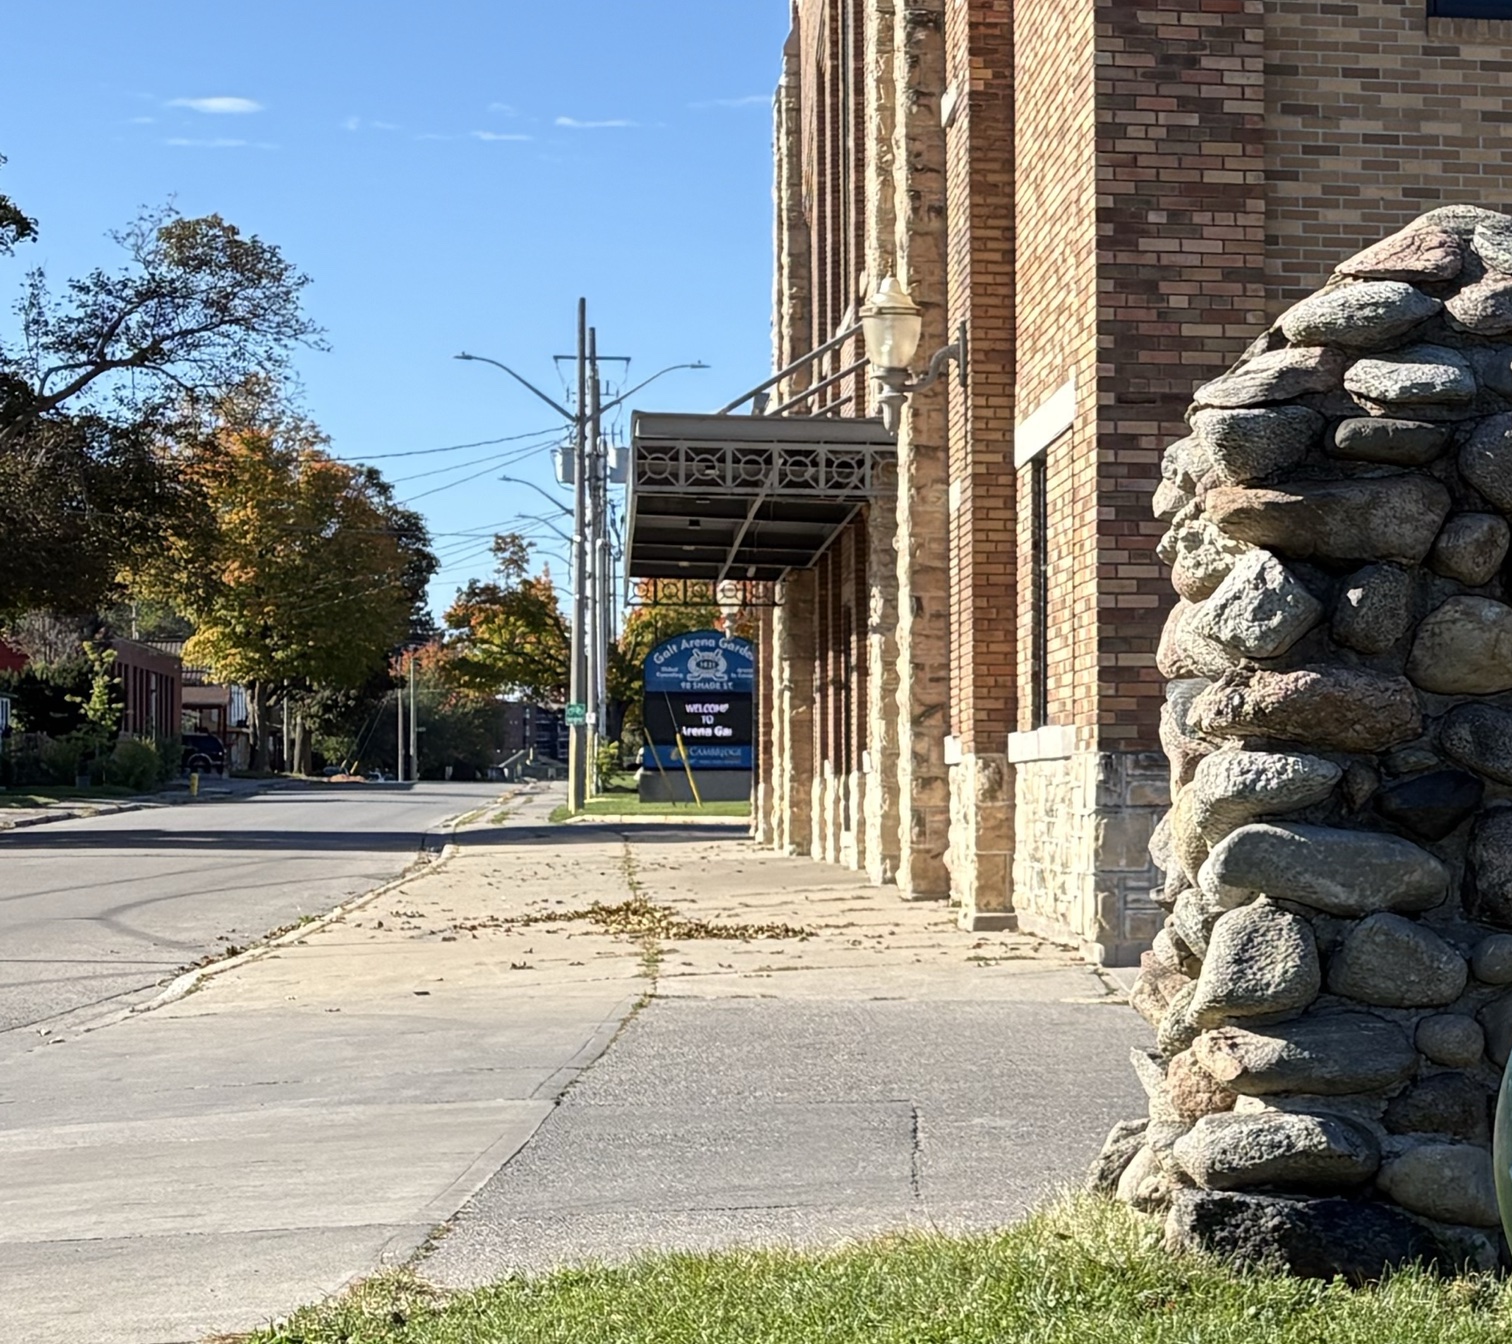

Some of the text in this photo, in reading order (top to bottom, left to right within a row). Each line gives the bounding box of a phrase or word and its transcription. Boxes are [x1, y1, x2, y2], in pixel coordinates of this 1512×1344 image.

[653, 643, 678, 664] Galt
[681, 638, 716, 650] Arena
[701, 715, 715, 725] TO
[682, 726, 713, 737] Arena
